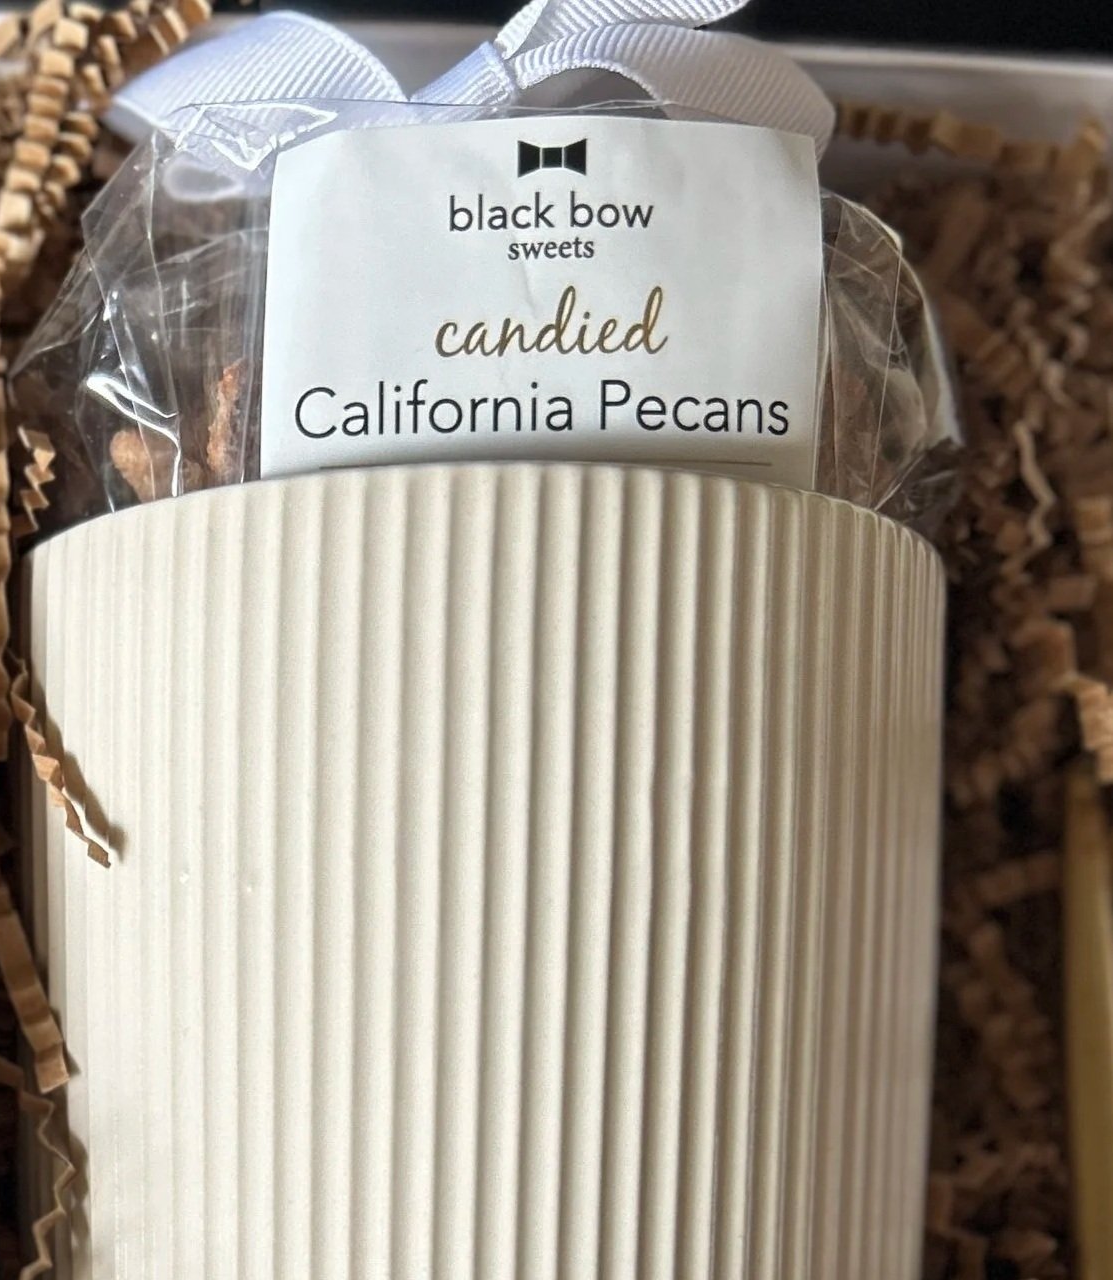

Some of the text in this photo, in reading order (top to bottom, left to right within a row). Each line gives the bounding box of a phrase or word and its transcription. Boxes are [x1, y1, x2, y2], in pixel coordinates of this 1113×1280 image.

[449, 190, 654, 233] black bow
[507, 237, 595, 261] sweets
[435, 286, 668, 358] candied
[295, 377, 789, 440] California Pecans
